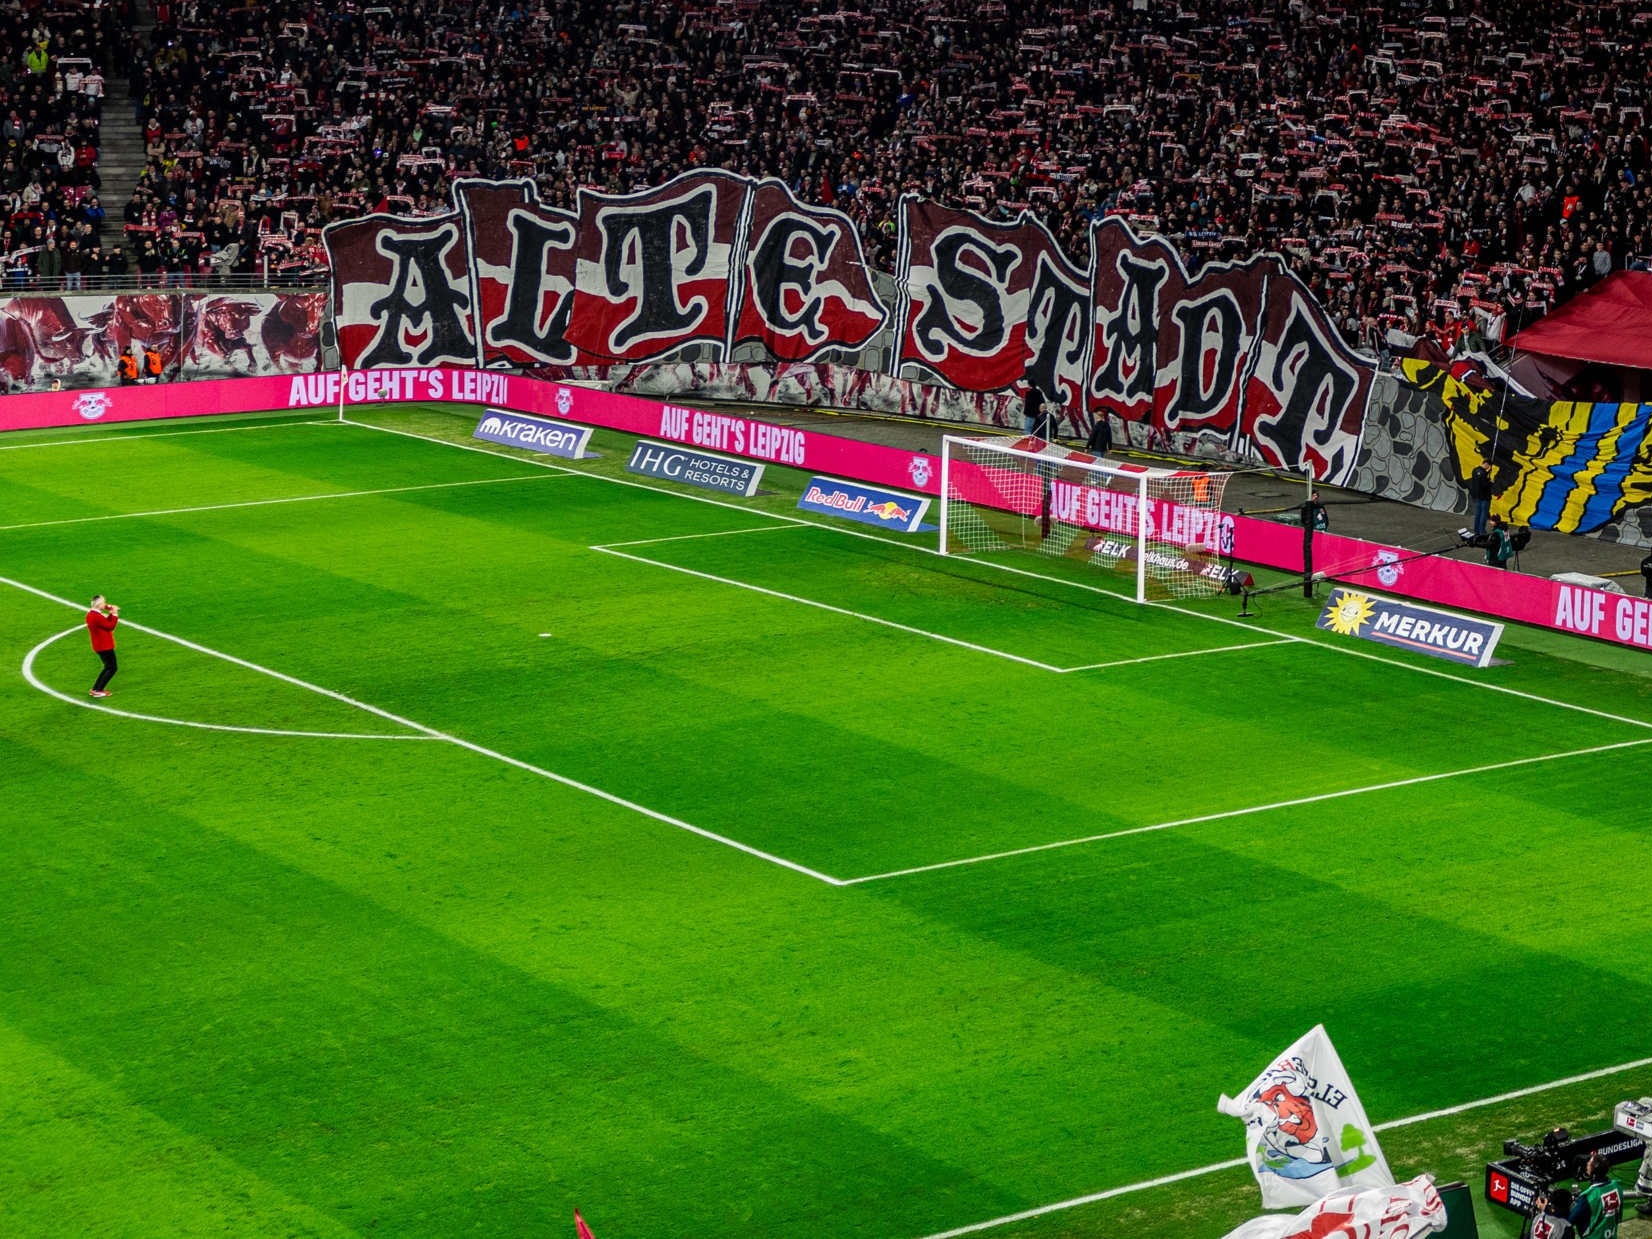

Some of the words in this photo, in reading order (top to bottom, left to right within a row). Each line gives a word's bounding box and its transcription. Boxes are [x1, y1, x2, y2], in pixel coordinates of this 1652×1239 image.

[358, 184, 841, 368] ALTE
[911, 225, 1357, 479] STADT
[288, 375, 341, 406] AUF
[349, 370, 444, 402] GEHT'S
[500, 420, 578, 451] kraken
[660, 406, 689, 439] AUF
[692, 412, 745, 453] GEHT'S
[749, 422, 805, 465] LEIPZIG
[630, 446, 684, 477] IHG
[689, 459, 741, 477] HOTELS
[741, 469, 750, 478] &
[684, 469, 746, 491] RESORTS
[1049, 481, 1081, 522] AUF
[1161, 502, 1235, 556] LEIPZIG
[1101, 541, 1131, 559] ELK
[1555, 585, 1606, 634] AUF
[1373, 611, 1485, 656] MERKUR
